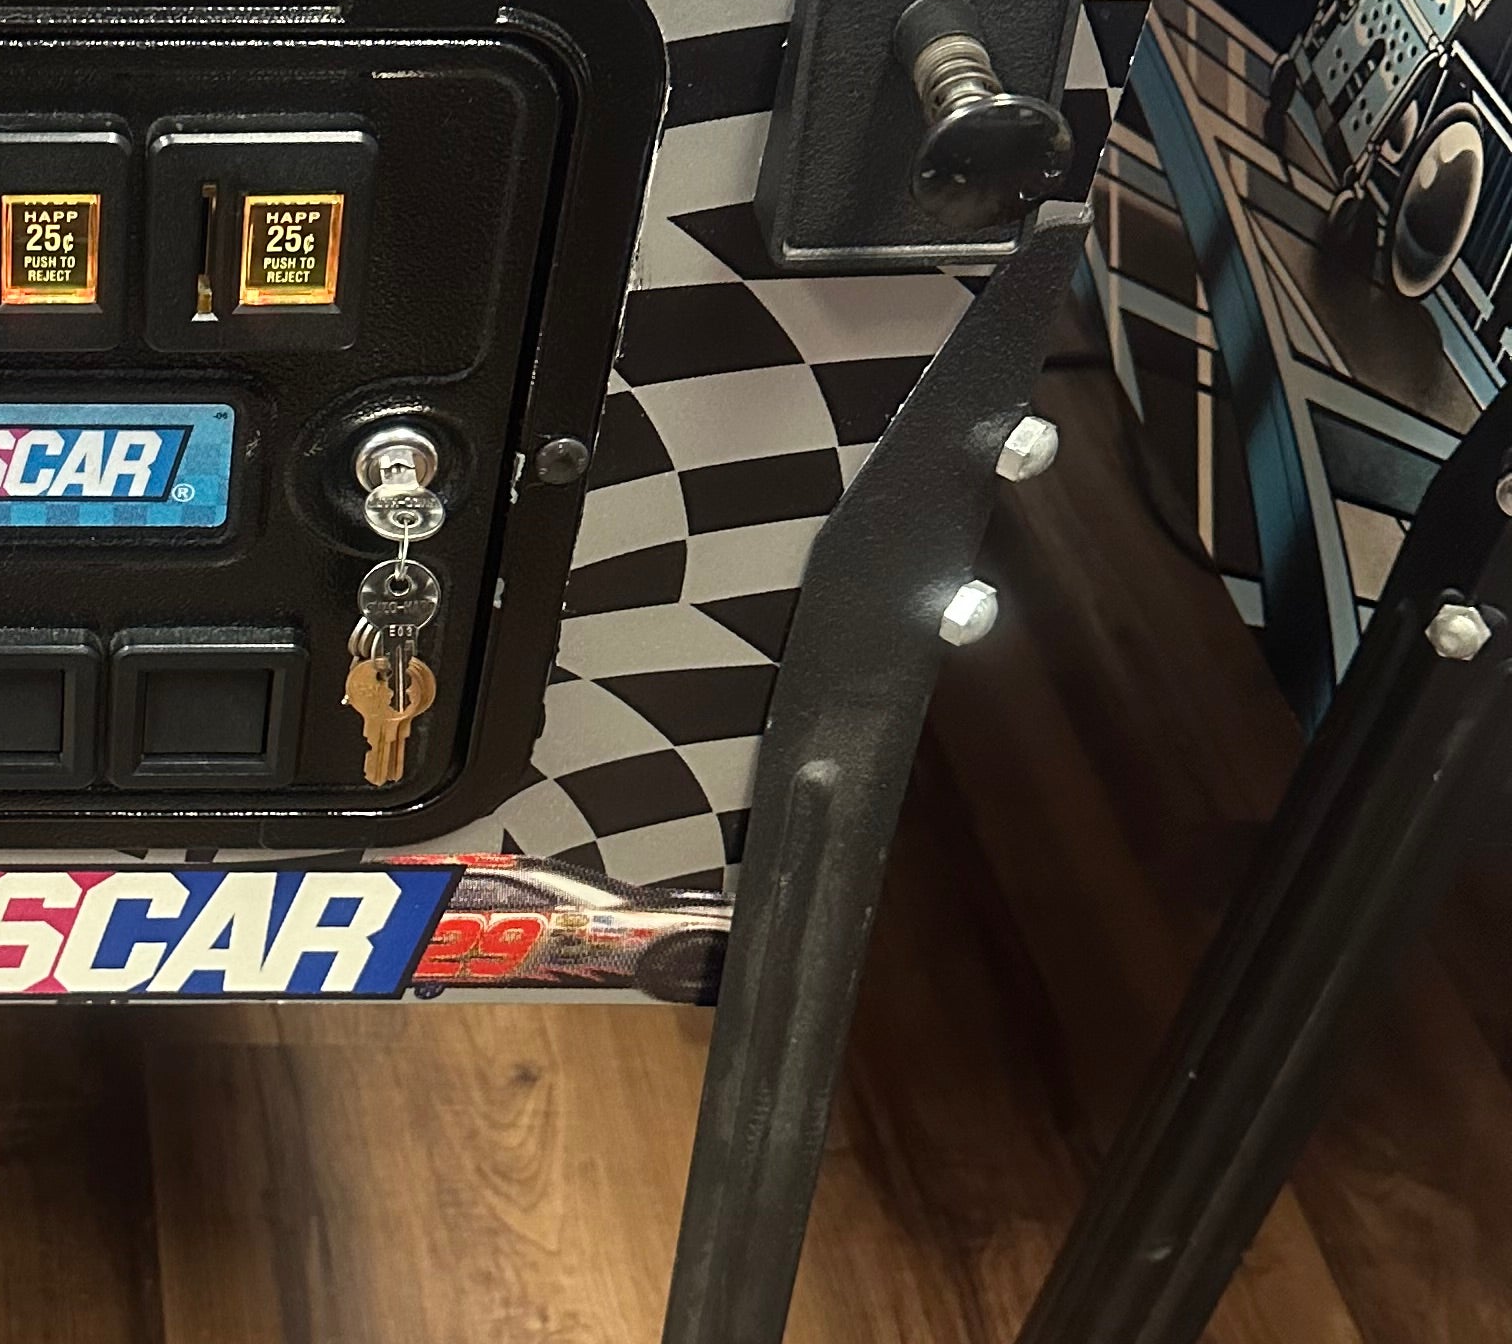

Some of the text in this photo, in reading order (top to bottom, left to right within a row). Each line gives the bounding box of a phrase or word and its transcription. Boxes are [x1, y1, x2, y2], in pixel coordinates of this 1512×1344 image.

[24, 211, 78, 222] HAPP
[266, 212, 321, 223] HAPP
[26, 224, 74, 253] 25¢
[266, 225, 315, 254] 25¢
[24, 256, 76, 268] PUSH TO
[264, 257, 315, 269] PUSH TO
[28, 270, 71, 282] REJECT
[267, 271, 310, 283] REJECT
[413, 912, 549, 978] 29
